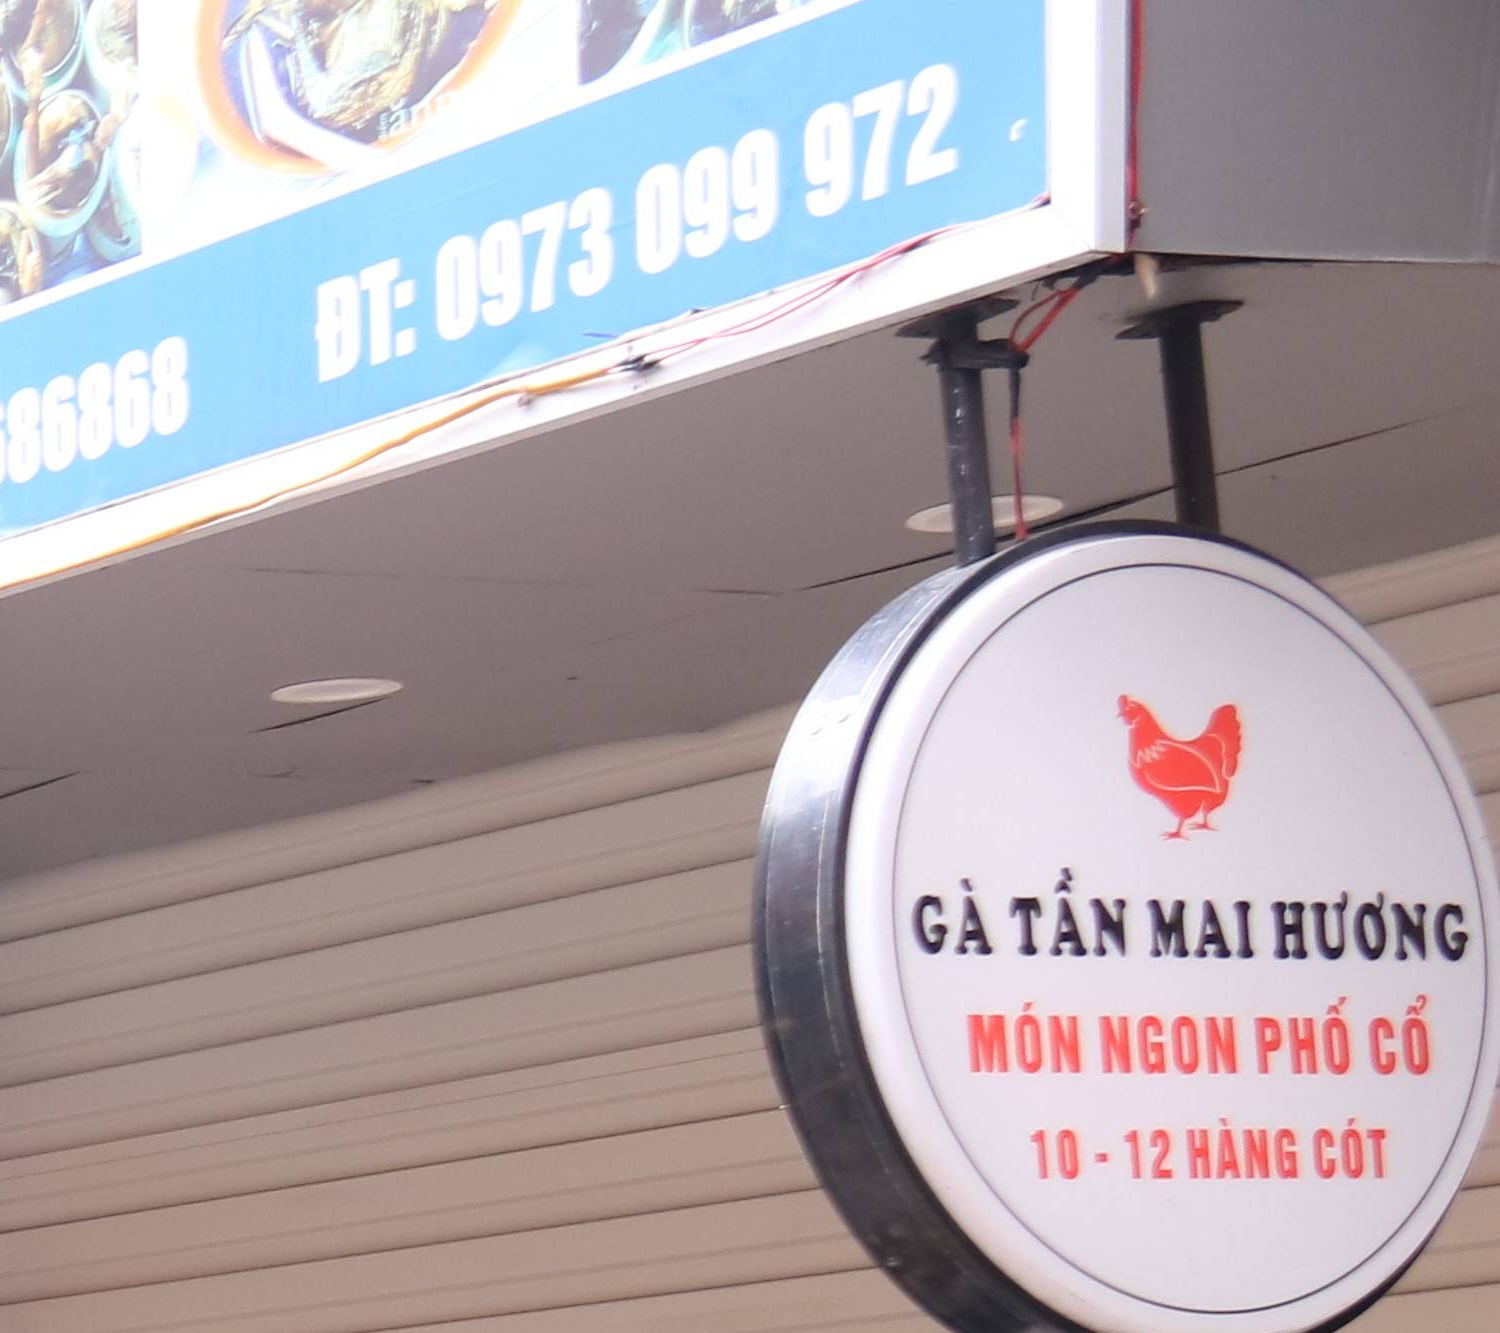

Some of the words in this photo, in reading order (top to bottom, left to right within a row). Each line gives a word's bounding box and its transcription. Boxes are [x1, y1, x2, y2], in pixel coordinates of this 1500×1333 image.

[313, 256, 418, 383] ĐT:
[433, 187, 615, 342] 0973
[634, 127, 780, 275] 099
[803, 62, 960, 217] 972
[912, 878, 992, 957] GÀ
[1009, 867, 1127, 961] TẦN
[1149, 897, 1251, 961] MAI
[1269, 890, 1470, 963] HƯƠNG
[967, 1003, 1082, 1075] MÓN
[1101, 1015, 1238, 1077] NGON
[1257, 996, 1351, 1077] PHỐ
[1369, 993, 1432, 1077] CỔ
[1030, 1128, 1081, 1181] 10
[1124, 1128, 1174, 1181] 12
[1187, 1117, 1299, 1181] HÀNG
[1314, 1117, 1388, 1181] CÓT
